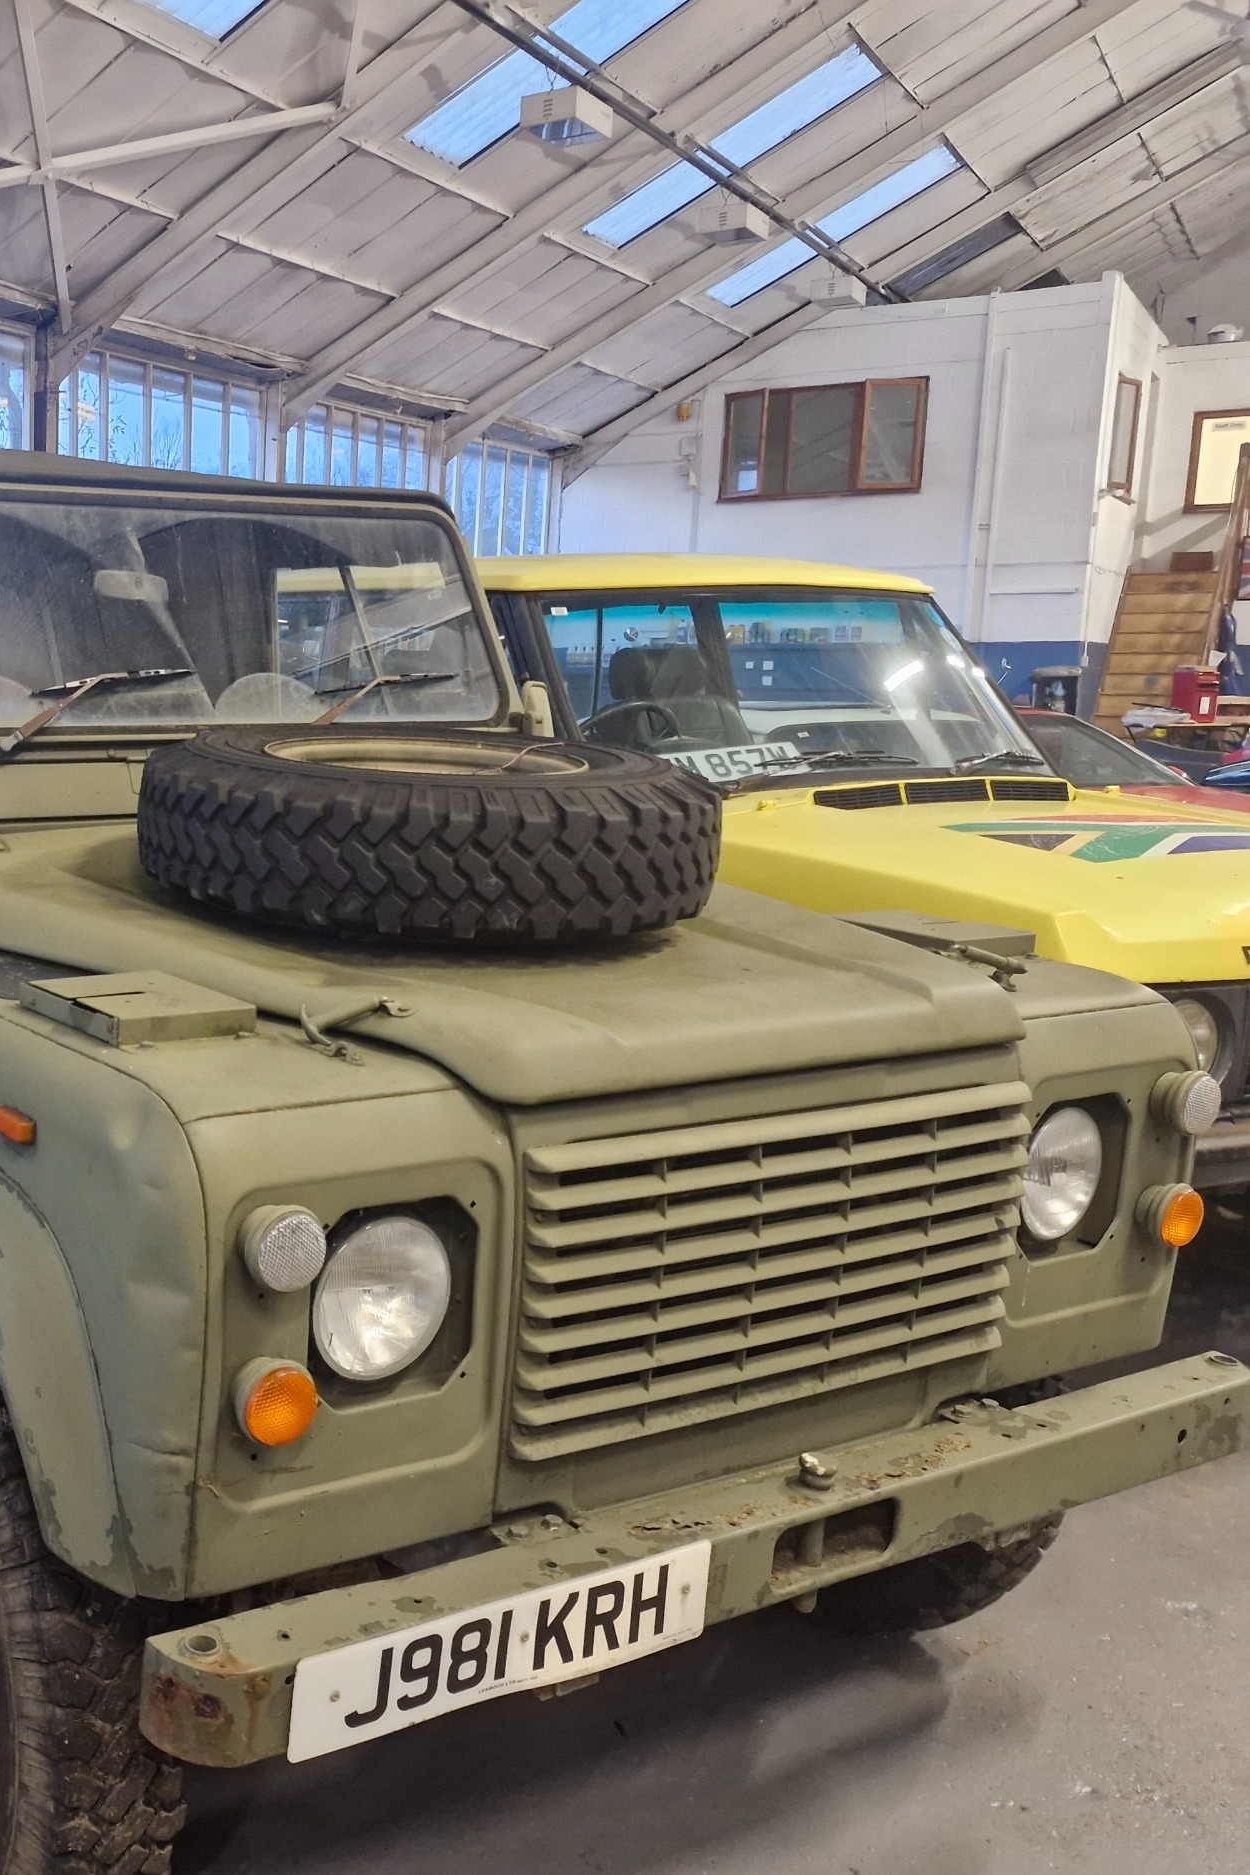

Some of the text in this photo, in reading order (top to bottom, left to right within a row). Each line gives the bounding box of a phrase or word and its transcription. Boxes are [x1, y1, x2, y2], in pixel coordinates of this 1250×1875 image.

[705, 746, 791, 778] 857W
[344, 1564, 670, 1728] J981 KRH
